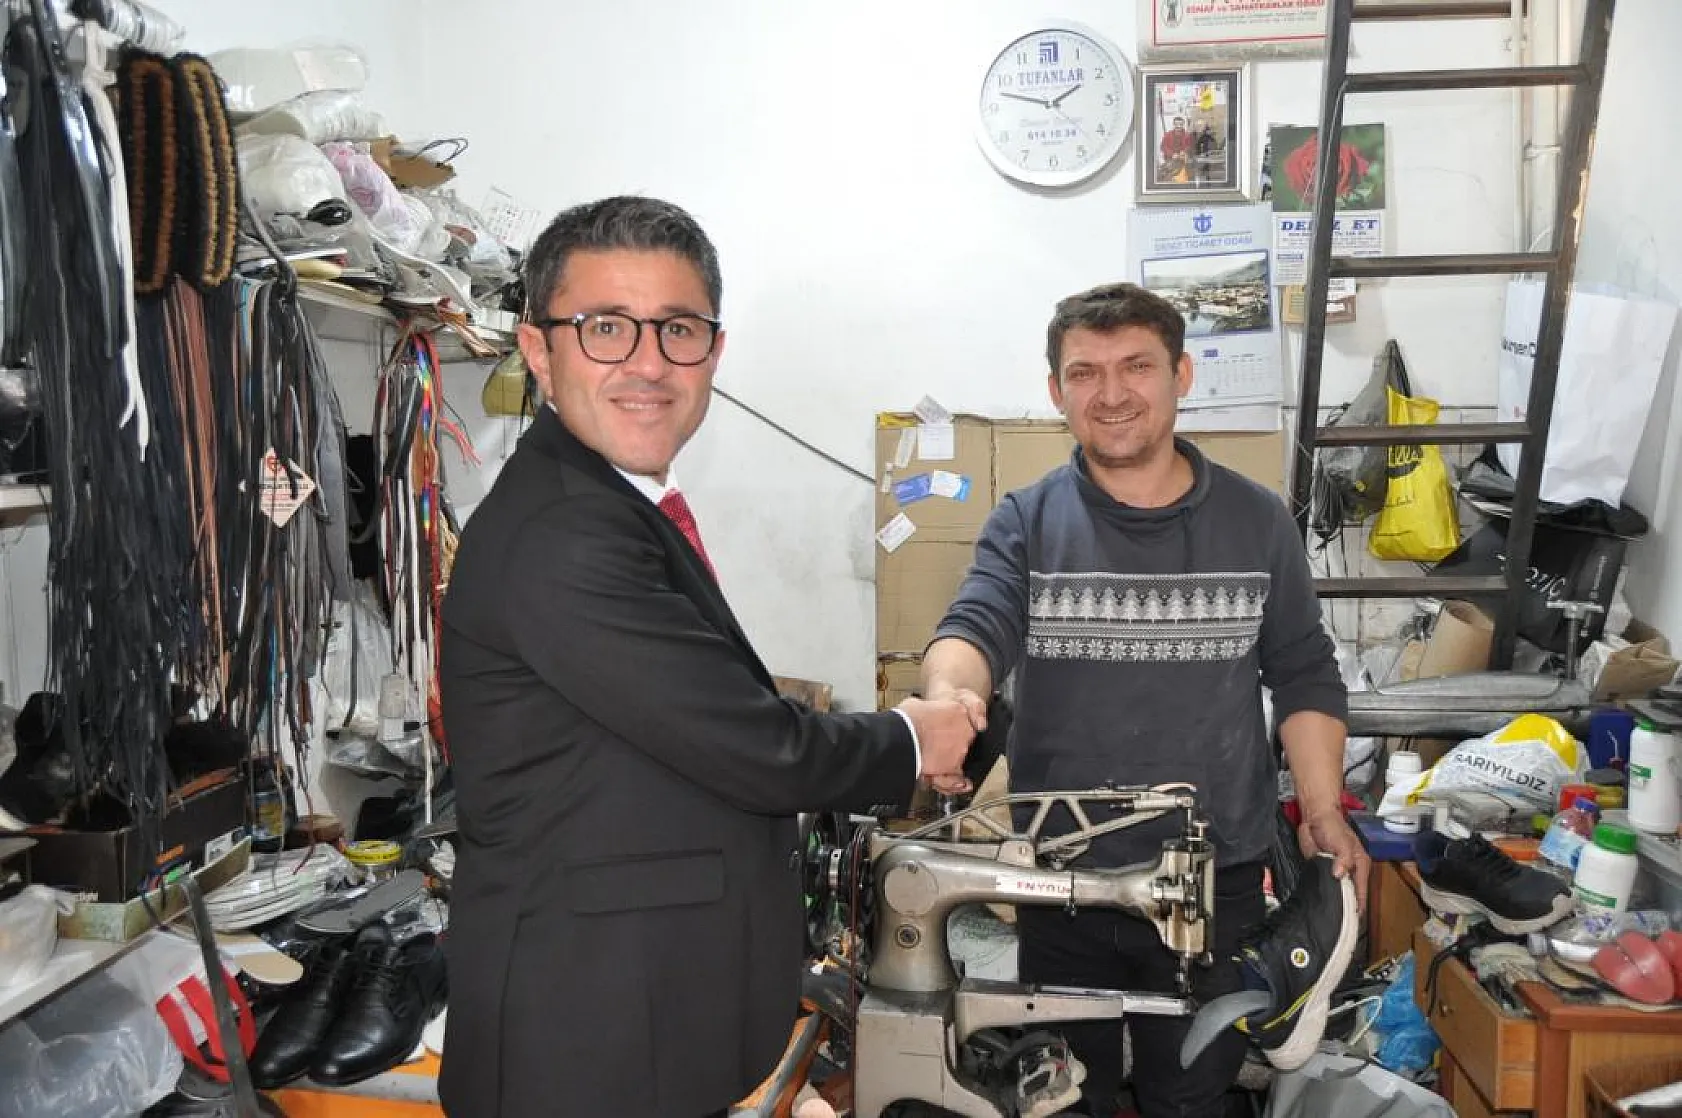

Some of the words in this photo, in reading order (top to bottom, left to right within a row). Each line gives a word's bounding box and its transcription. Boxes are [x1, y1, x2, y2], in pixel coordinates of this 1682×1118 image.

[1018, 68, 1083, 86] TUFANLAR
[1094, 68, 1104, 79] 2
[1353, 219, 1378, 230] ET
[1455, 754, 1547, 791] SARIYILDIZ
